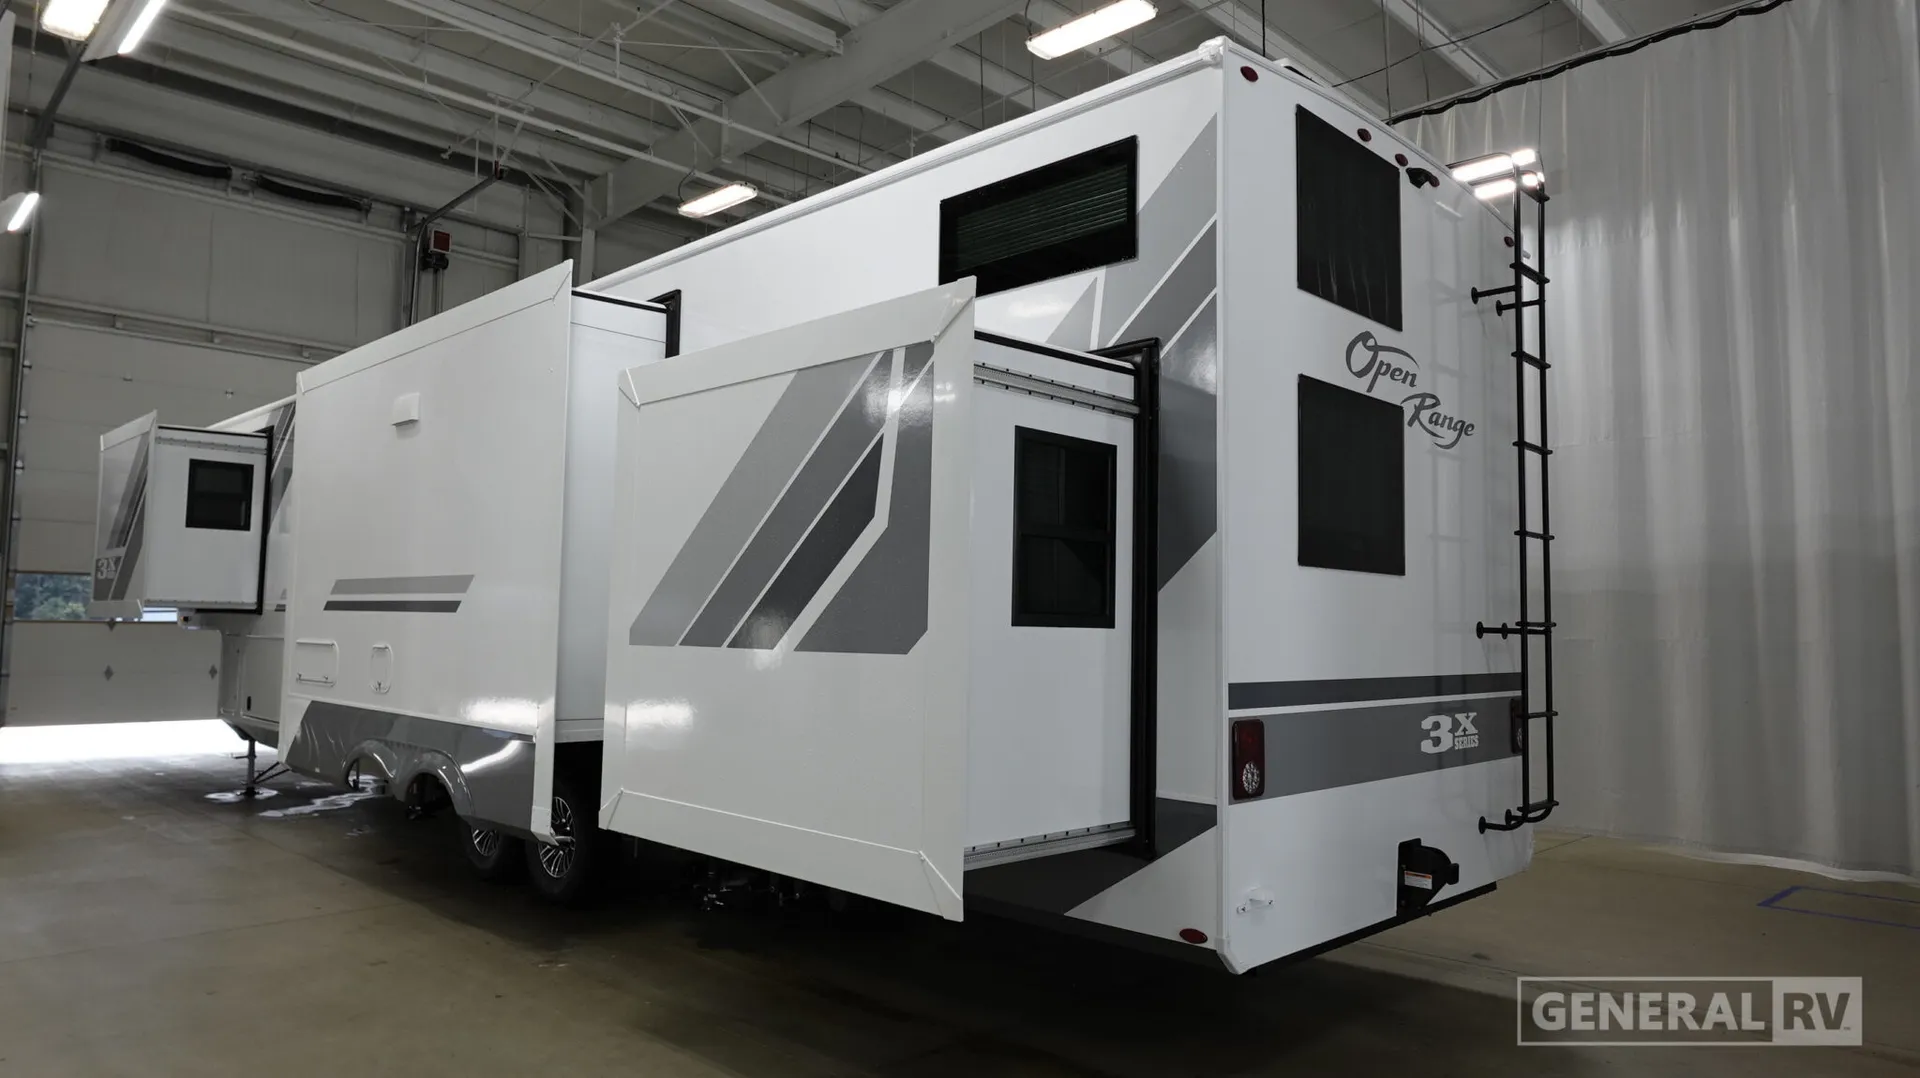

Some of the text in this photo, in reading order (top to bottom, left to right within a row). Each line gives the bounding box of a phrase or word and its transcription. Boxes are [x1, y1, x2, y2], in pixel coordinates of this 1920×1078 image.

[1345, 330, 1420, 393] Open
[1400, 392, 1475, 450] Range
[1454, 735, 1479, 750] SERIES
